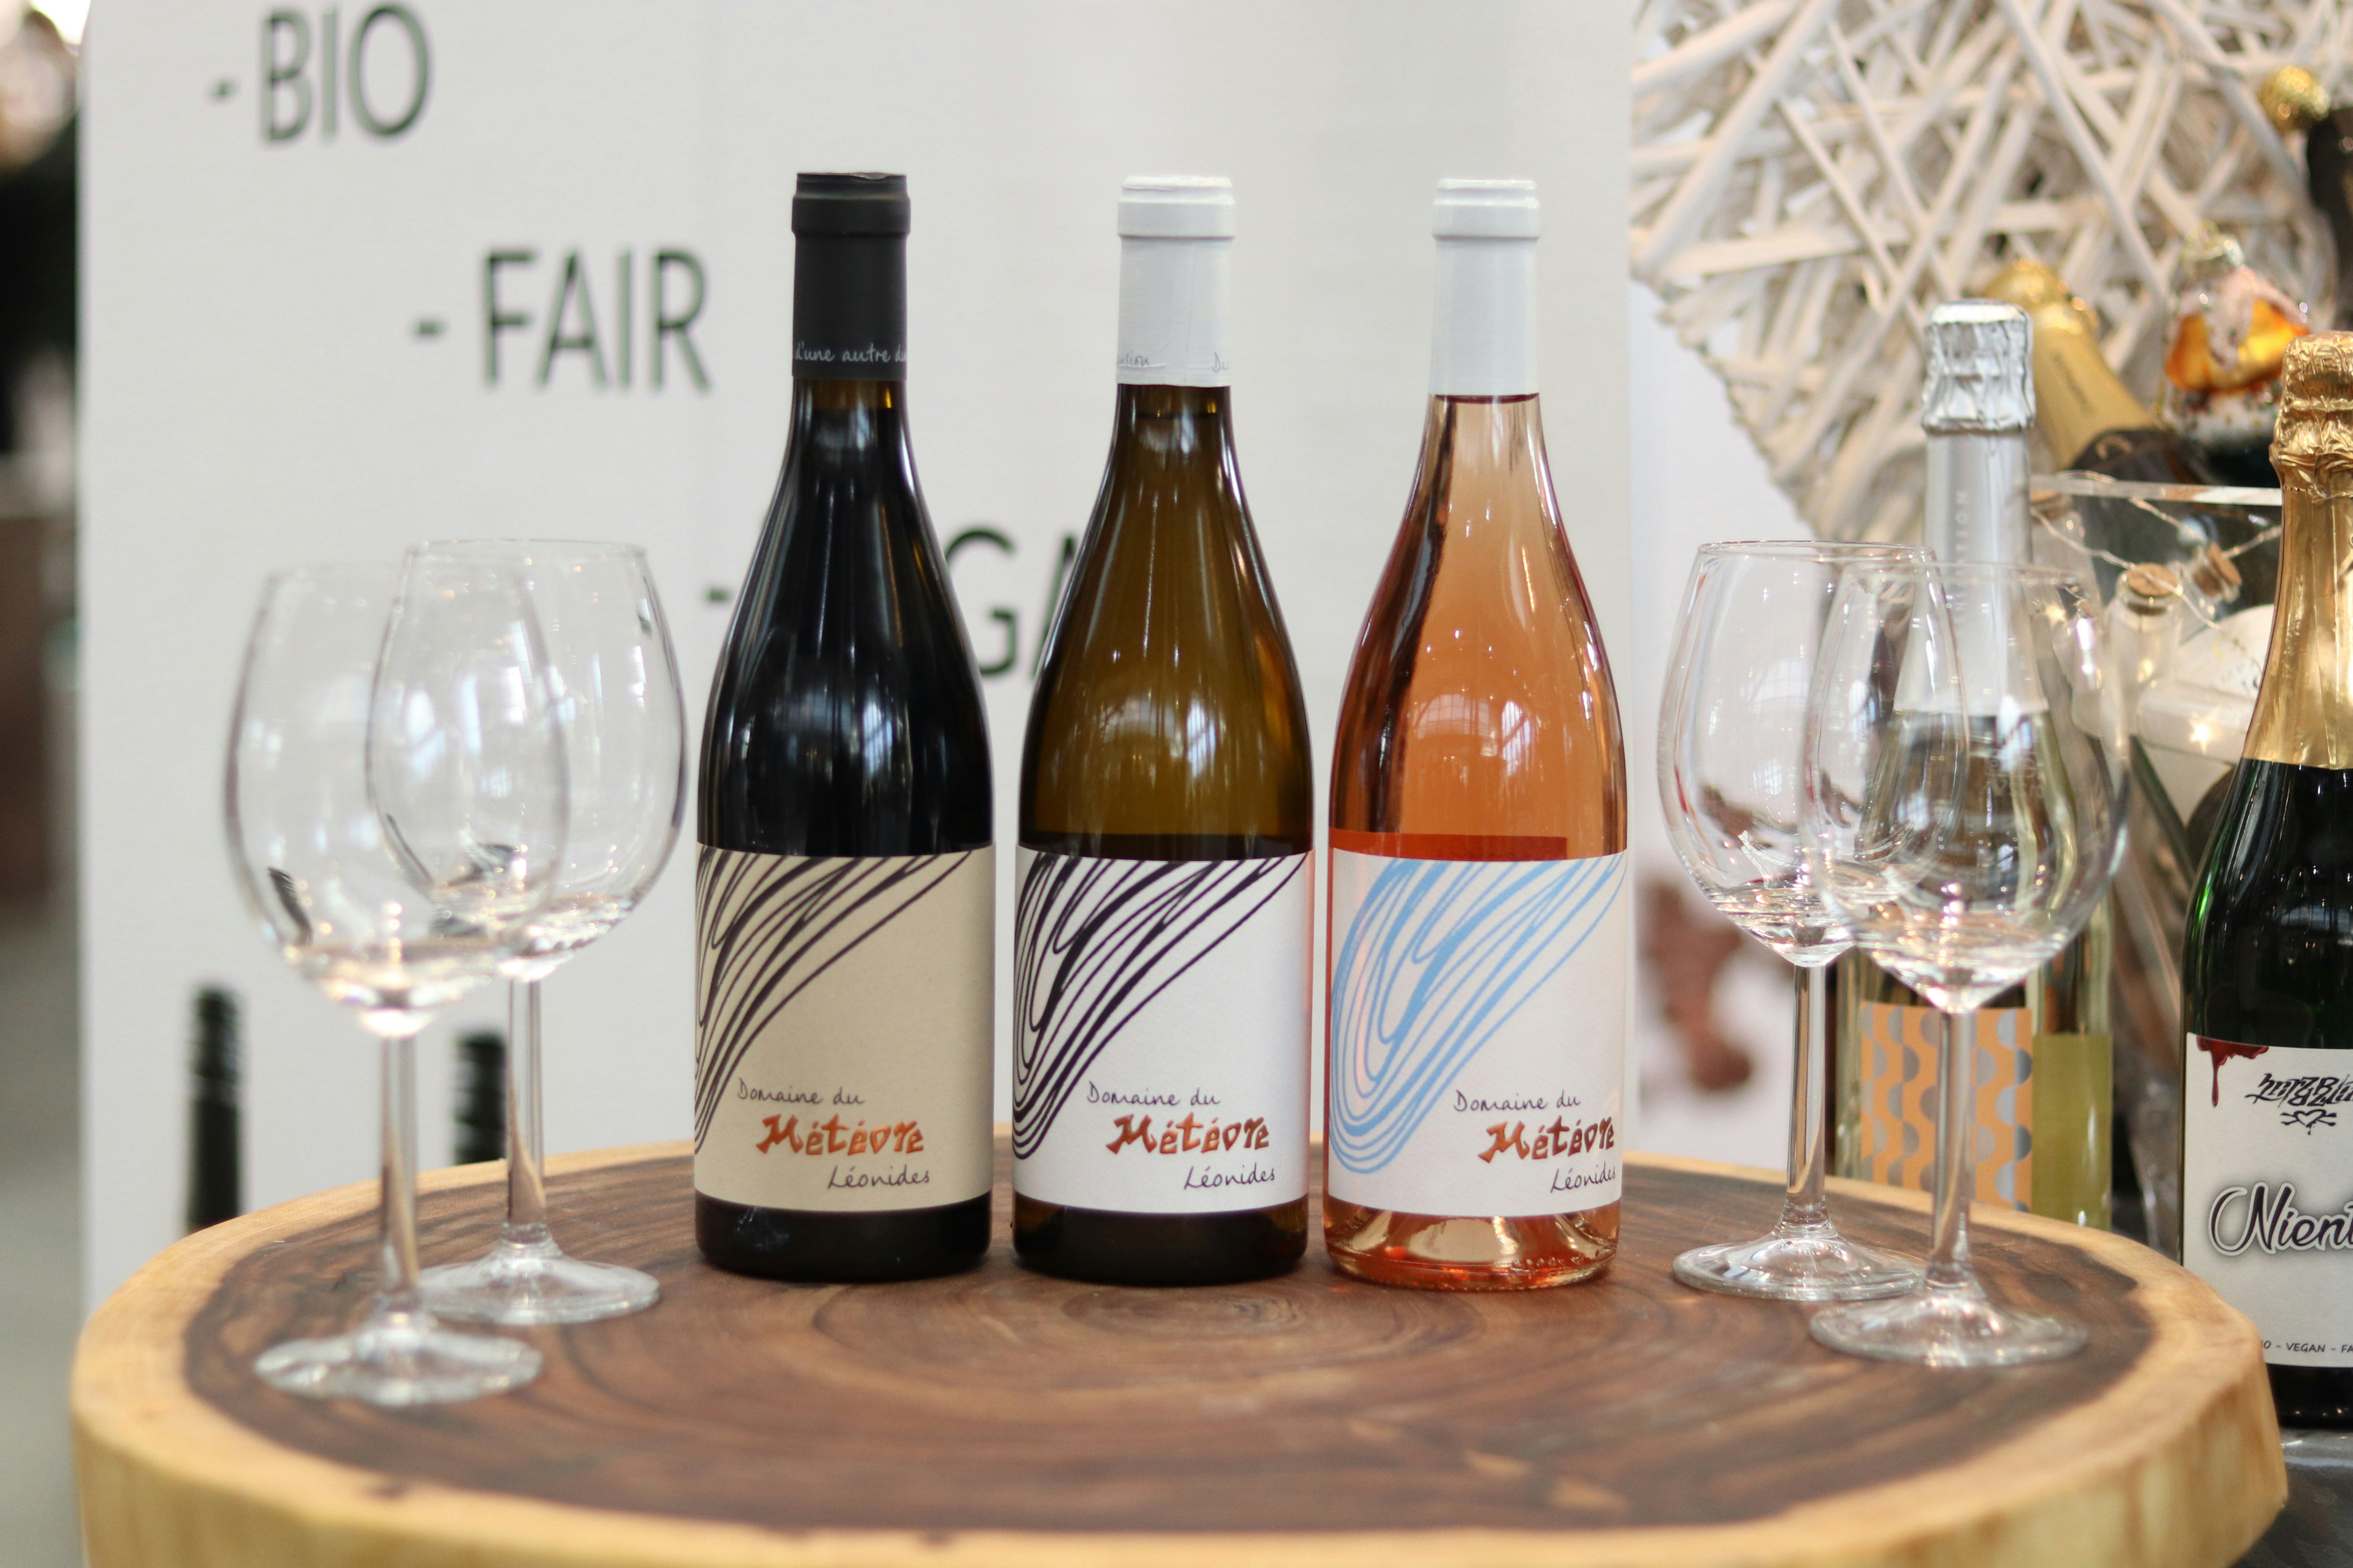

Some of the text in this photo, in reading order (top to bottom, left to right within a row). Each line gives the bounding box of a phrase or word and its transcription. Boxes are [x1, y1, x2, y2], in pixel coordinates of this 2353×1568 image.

[260, 3, 432, 143] BIO
[482, 248, 713, 391] FAIR
[842, 343, 891, 363] autre
[738, 1077, 865, 1105] Domaine du
[1087, 1081, 1220, 1106] Domaine du
[1453, 1089, 1581, 1112] Domaine du
[756, 1113, 924, 1156] Météore
[1106, 1112, 1269, 1155] Météore
[1477, 1115, 1614, 1163] Météore
[827, 1164, 930, 1189] Léonides
[1183, 1162, 1275, 1190] Léonides
[1550, 1161, 1615, 1193] Léonides
[2286, 1342, 2326, 1353] VEGAN
